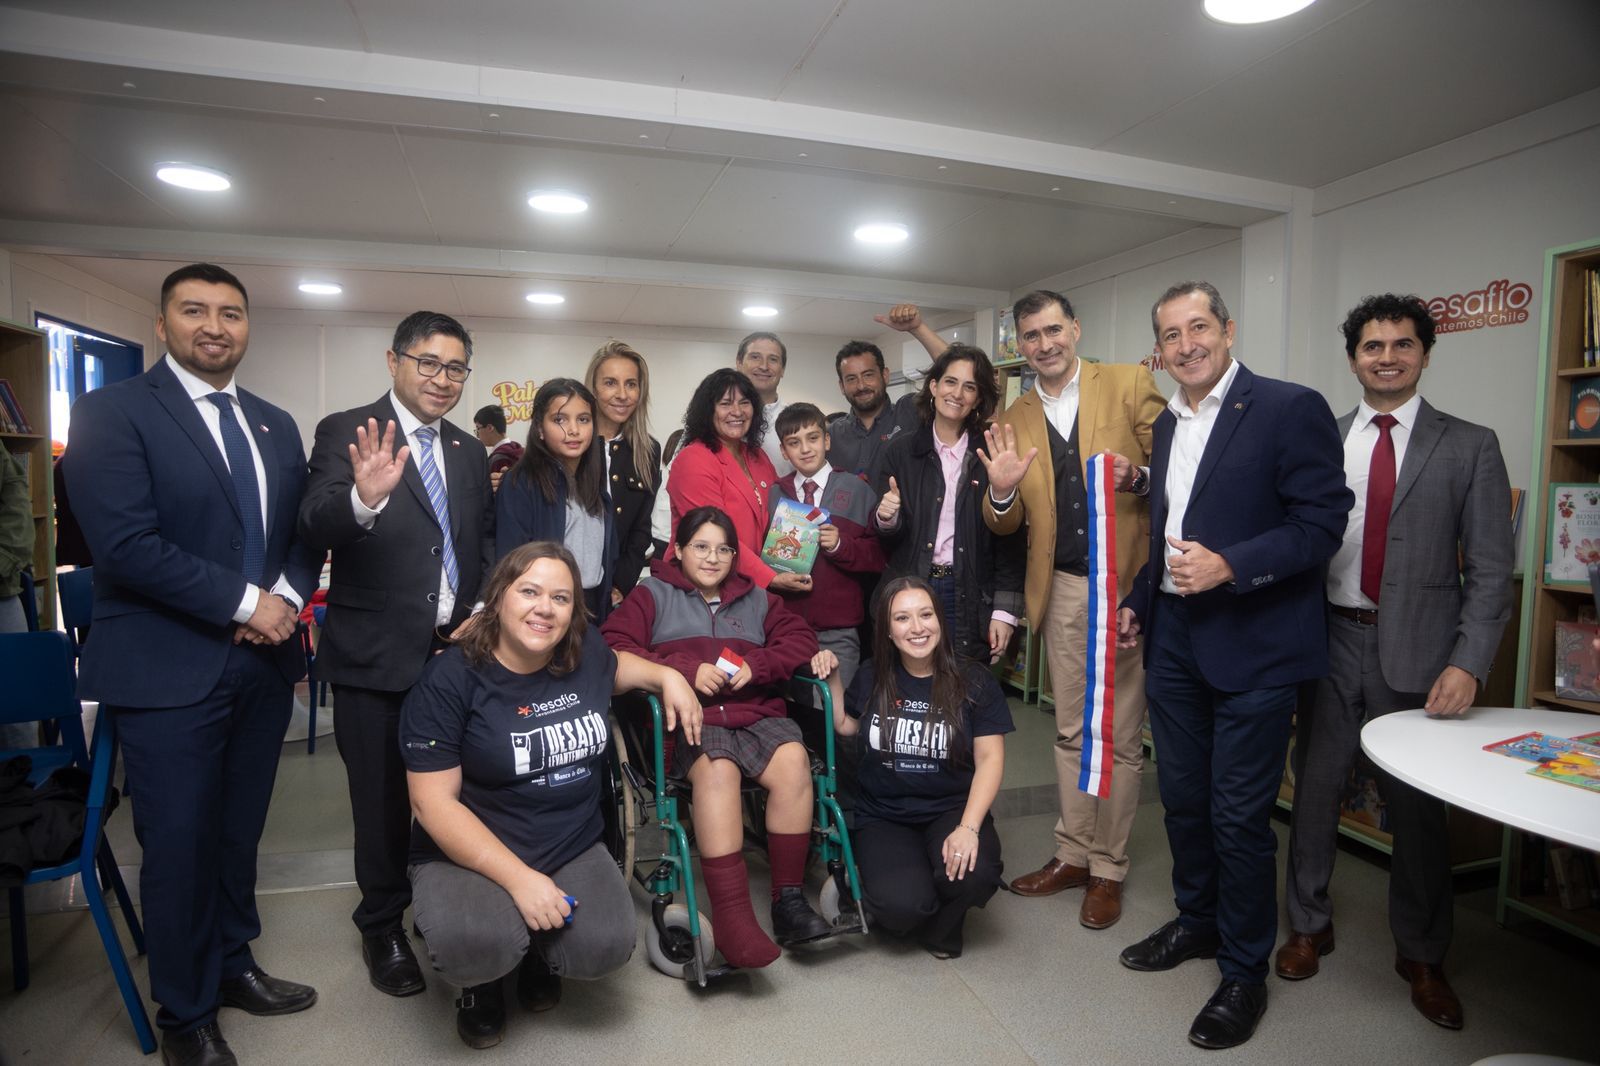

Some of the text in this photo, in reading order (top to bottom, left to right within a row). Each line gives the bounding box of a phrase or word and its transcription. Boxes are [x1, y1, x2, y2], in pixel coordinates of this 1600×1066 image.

[1419, 281, 1530, 320] esafío
[1434, 311, 1526, 334] ntemos Chile
[535, 700, 580, 718] Levantemos Chile
[543, 709, 607, 756] DESAFÍO
[548, 746, 588, 768] LEVANTEMOS
[894, 743, 928, 757] LEVANTEMOS
